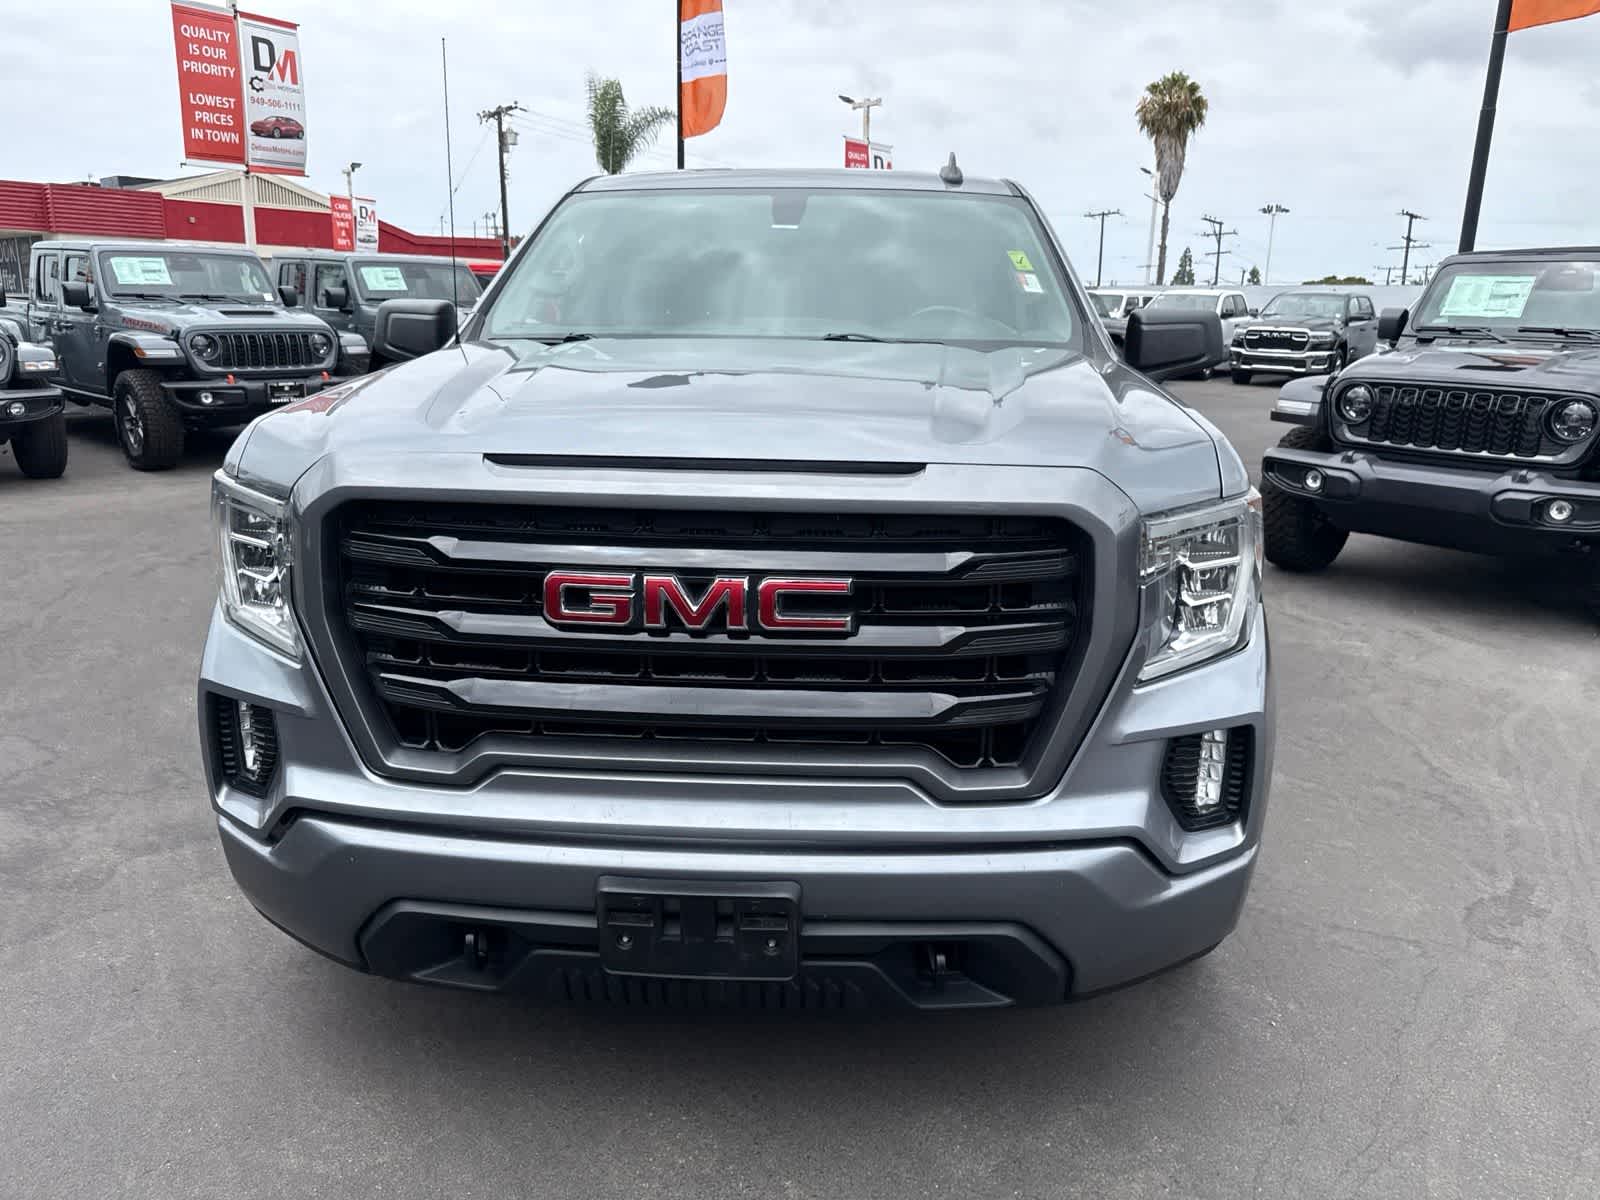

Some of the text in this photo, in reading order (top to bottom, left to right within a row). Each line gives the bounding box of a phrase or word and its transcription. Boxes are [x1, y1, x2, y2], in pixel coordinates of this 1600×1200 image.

[180, 24, 231, 43] QUALITY
[188, 42, 227, 60] IS OUR
[183, 60, 236, 79] PRIORITY
[189, 92, 236, 110] LOWEST
[250, 95, 301, 112] 949-506-1111
[195, 110, 233, 127] PRICES
[191, 127, 240, 144] IN TOWN
[543, 570, 853, 631] GMC
